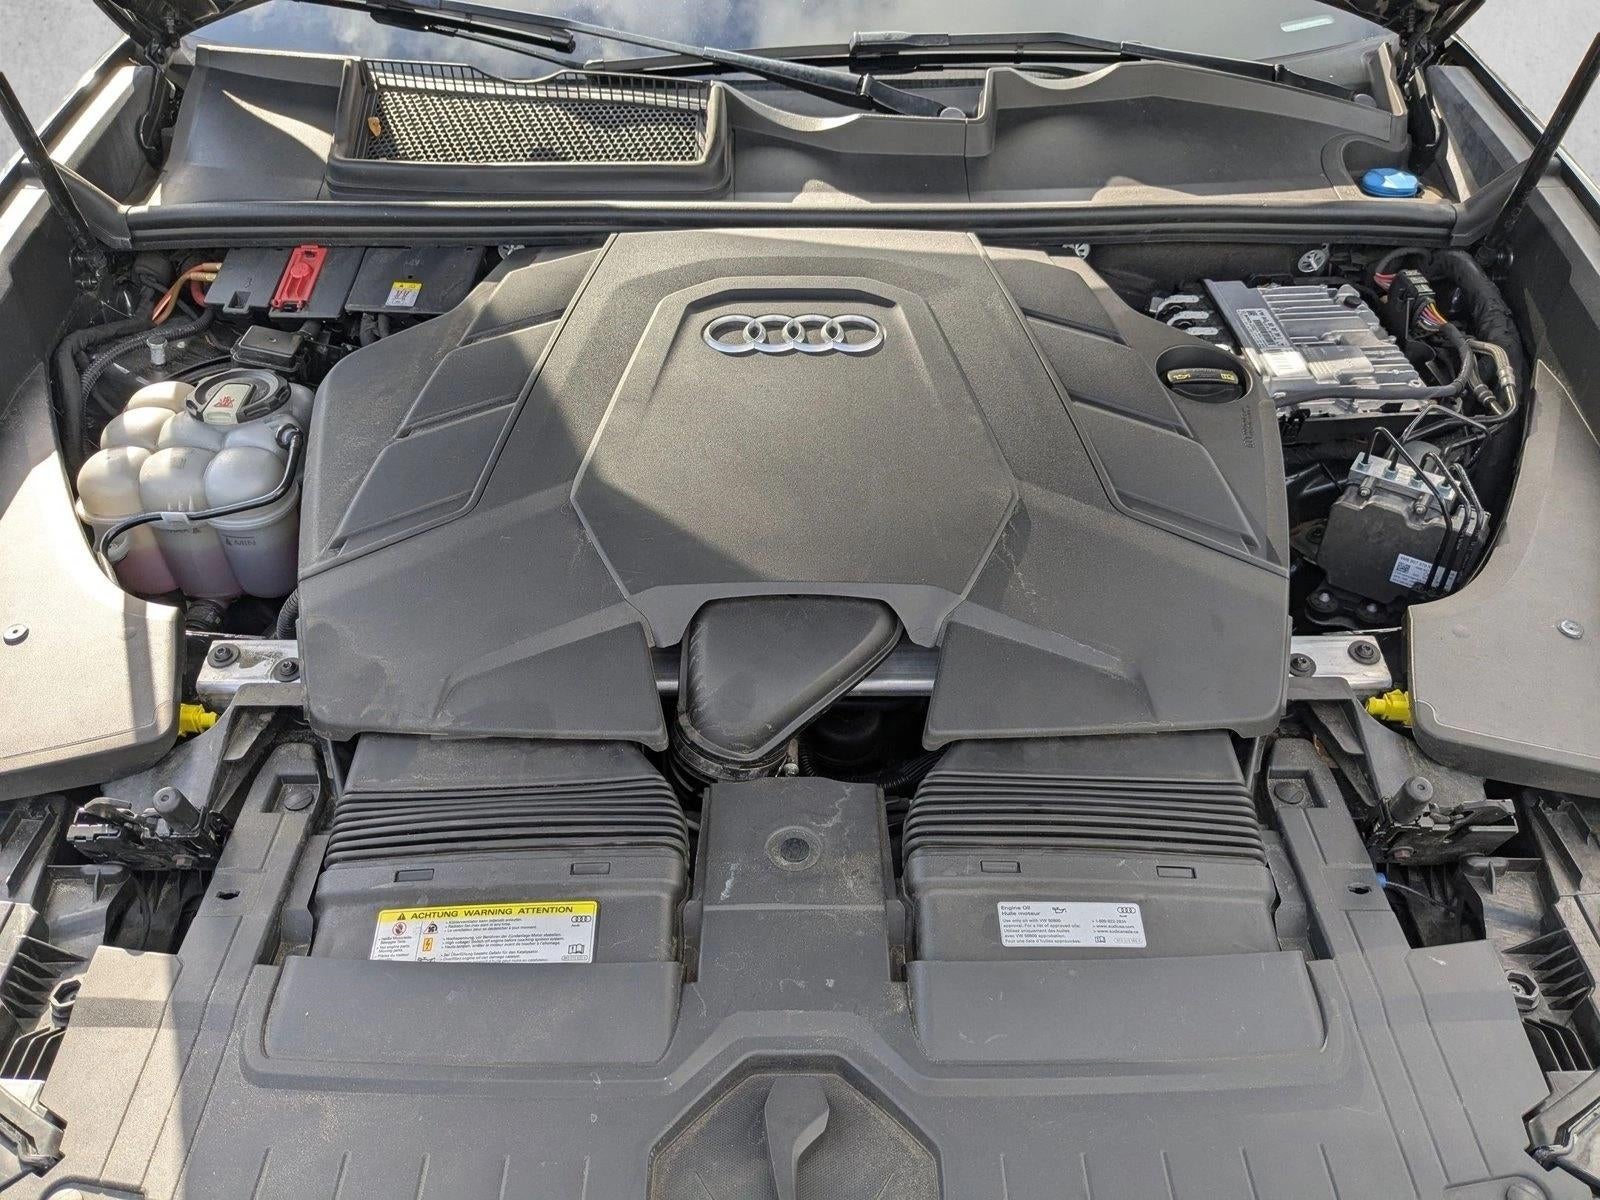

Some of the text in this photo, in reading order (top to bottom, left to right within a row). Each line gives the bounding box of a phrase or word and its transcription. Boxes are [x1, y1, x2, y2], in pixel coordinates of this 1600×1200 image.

[411, 906, 573, 920] ACHTUNG WARNING ATTENTION
